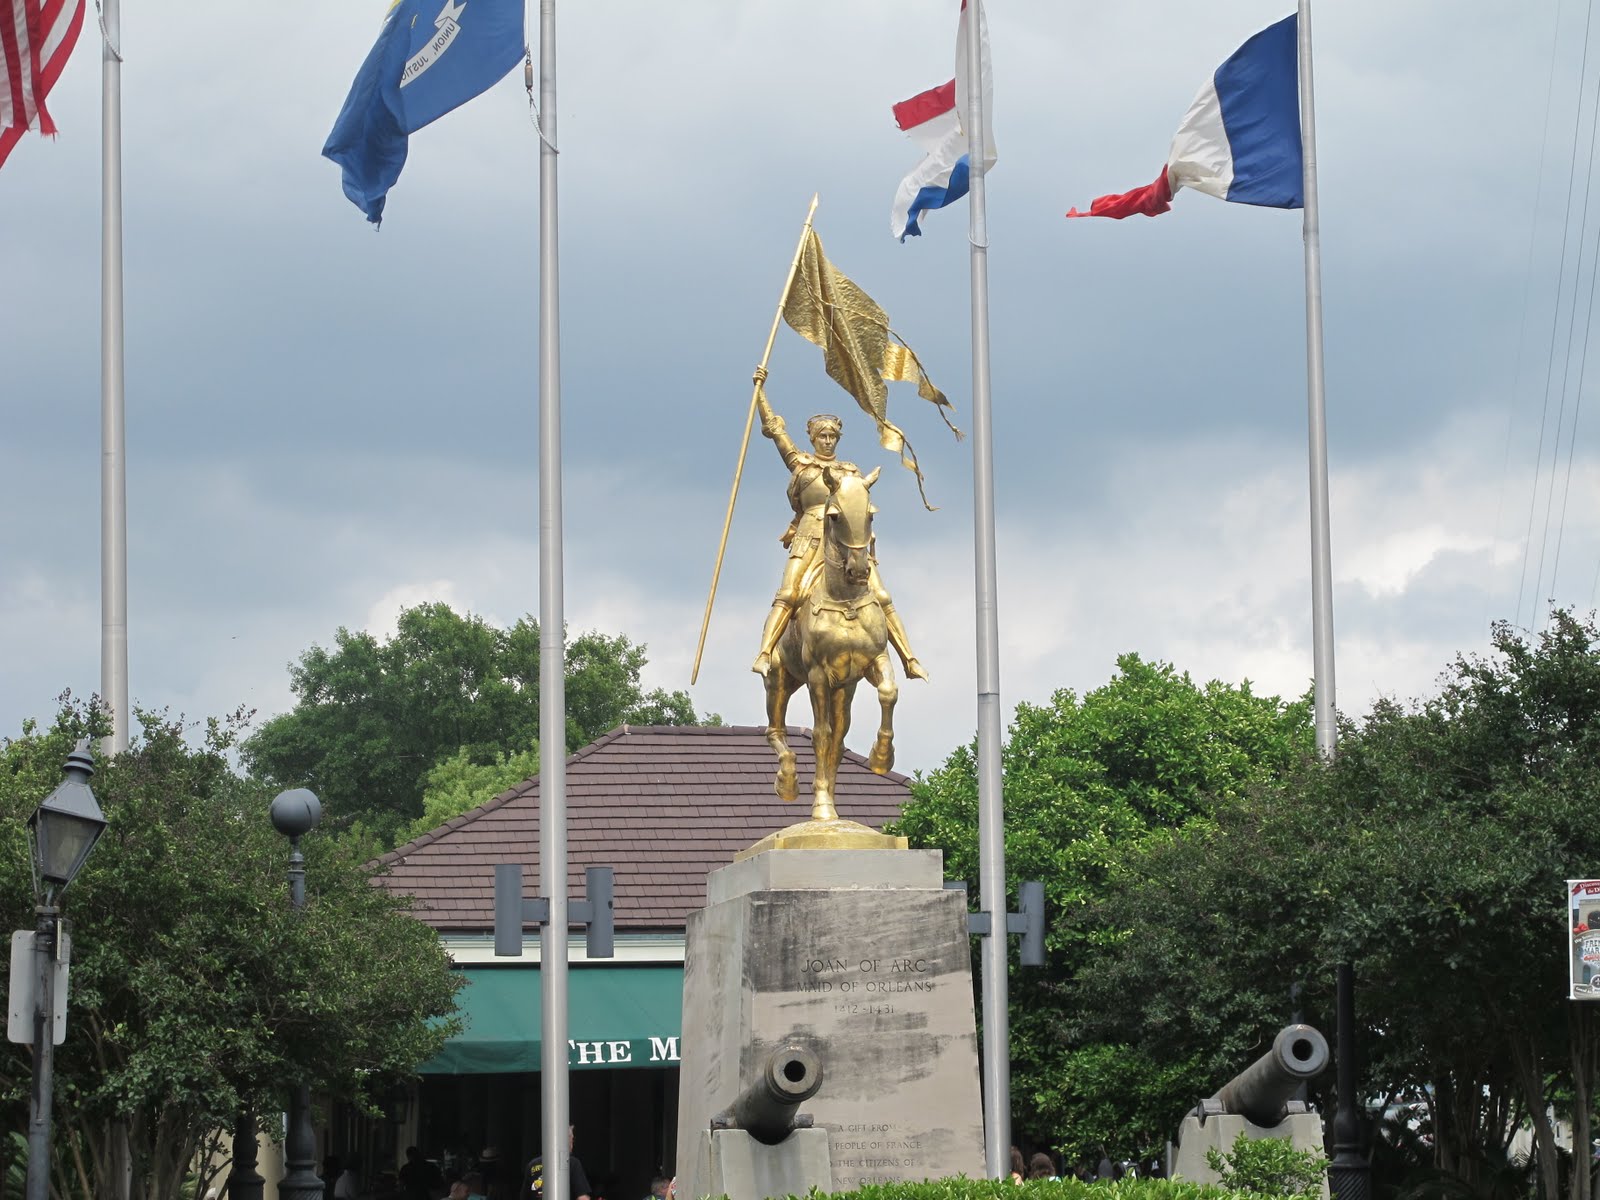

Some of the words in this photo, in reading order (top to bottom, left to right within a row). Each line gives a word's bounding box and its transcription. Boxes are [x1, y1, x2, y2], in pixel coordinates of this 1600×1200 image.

[801, 959, 848, 973] JOAN
[859, 959, 881, 973] OF
[891, 959, 927, 973] ARC
[796, 981, 833, 993] MAID
[840, 981, 859, 993] OF
[866, 981, 932, 993] ORLEANS
[848, 1124, 866, 1132] GIFT
[835, 1142, 866, 1150] PEOPLE
[870, 1141, 881, 1150] OF
[886, 1141, 922, 1149] FRANCE
[839, 1160, 854, 1168] THE
[859, 1159, 900, 1168] CITIZENS
[903, 1158, 915, 1167] OF
[836, 1177, 856, 1185] NEW
